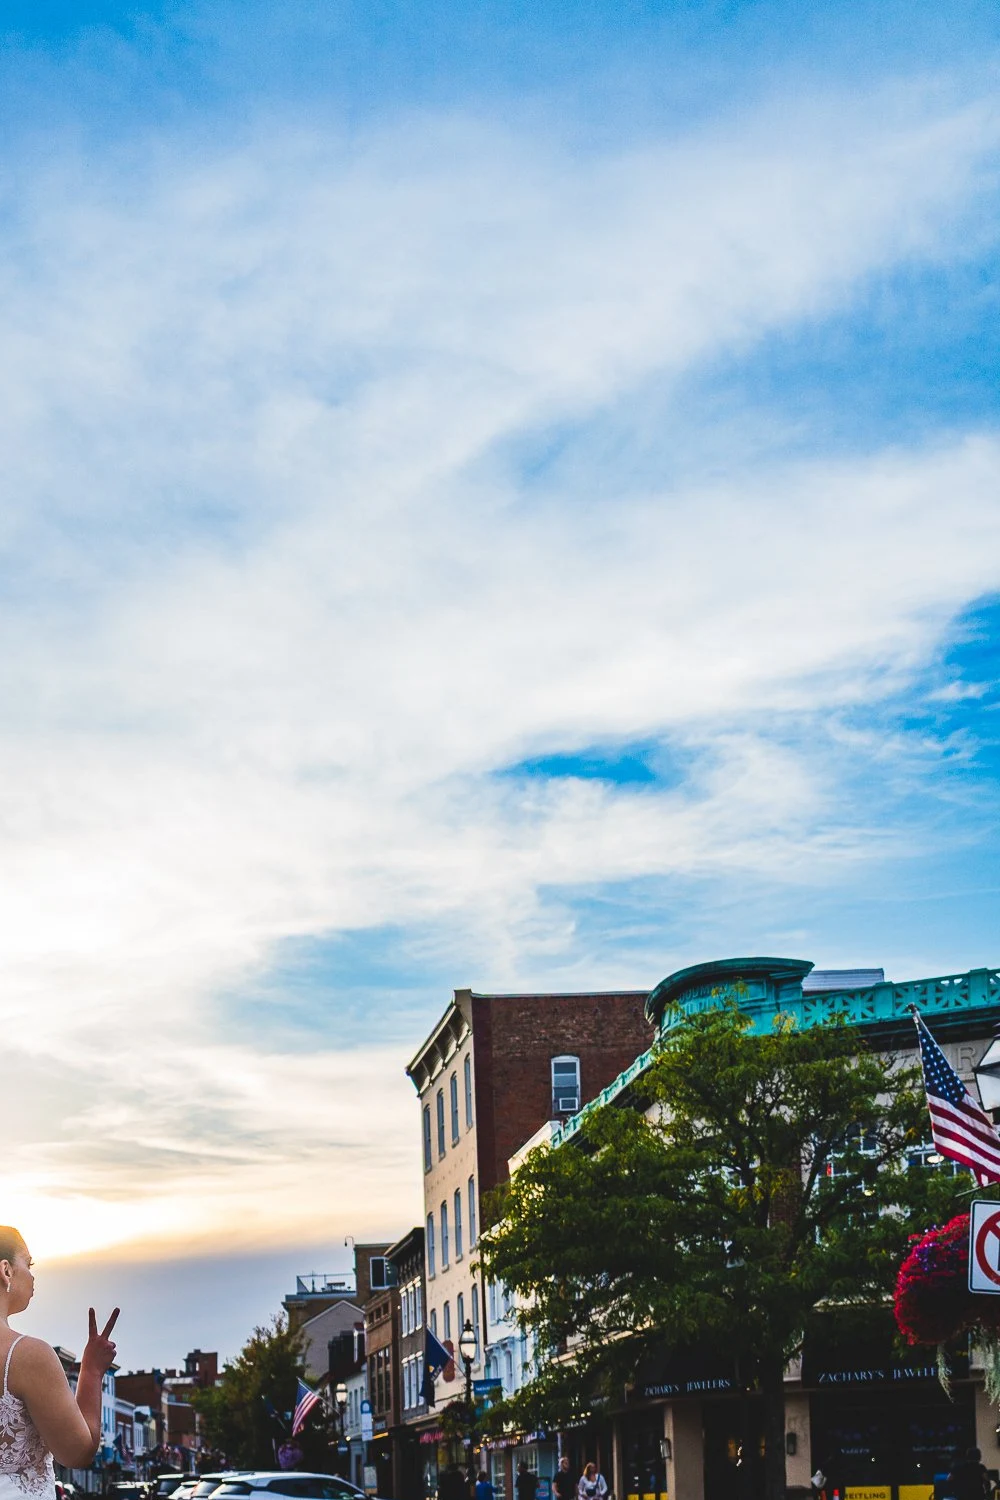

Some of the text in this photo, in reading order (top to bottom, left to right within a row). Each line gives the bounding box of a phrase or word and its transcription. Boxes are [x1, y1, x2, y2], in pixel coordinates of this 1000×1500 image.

[818, 1366, 953, 1384] ZACHARY'S JEWELES
[644, 1378, 731, 1397] ZACHARY'S JEWELERS
